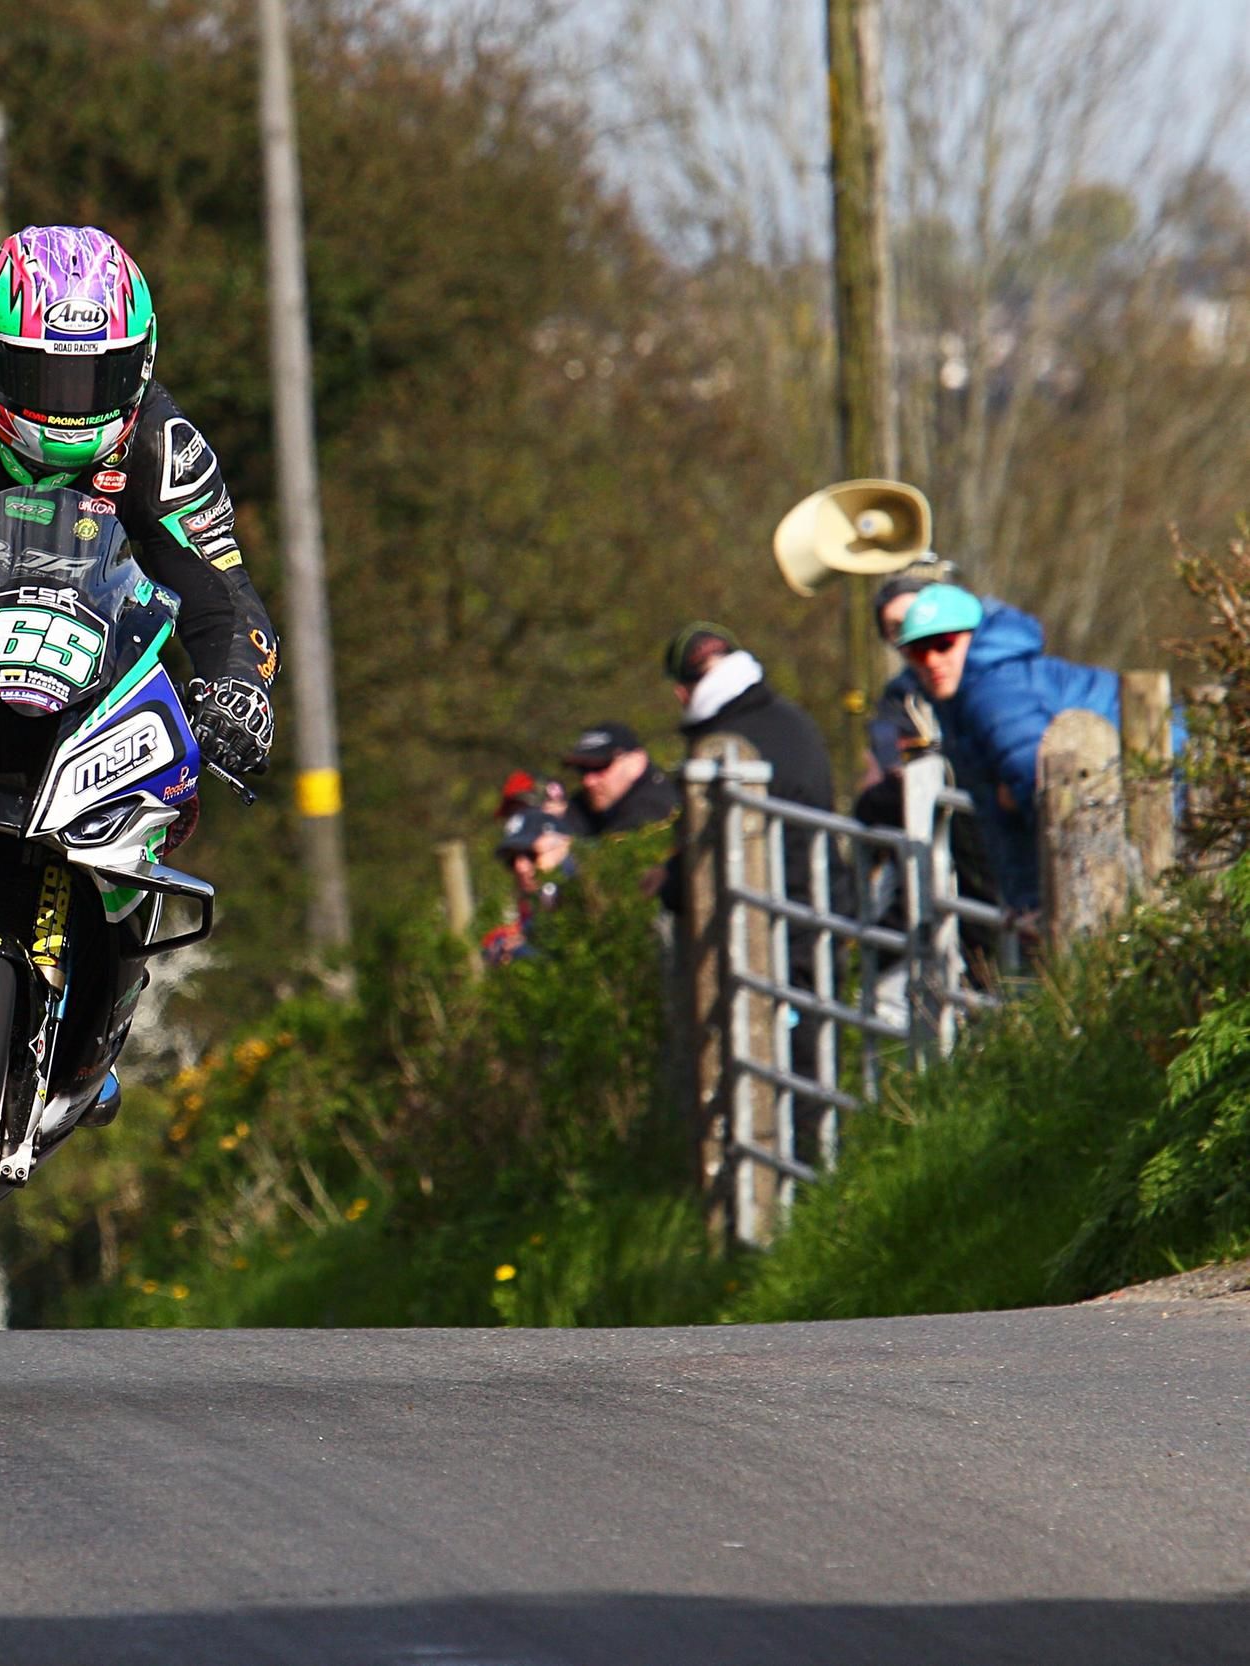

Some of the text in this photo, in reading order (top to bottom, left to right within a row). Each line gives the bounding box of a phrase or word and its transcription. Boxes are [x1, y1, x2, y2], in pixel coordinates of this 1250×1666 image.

[49, 303, 101, 323] Arai
[53, 343, 73, 352] ROAD
[22, 408, 121, 426] ROAD RACING IRELAND
[27, 677, 69, 698] TRANSPORT
[28, 670, 71, 693] Walton
[74, 724, 157, 795] MJR
[164, 775, 199, 796] Roadstar
